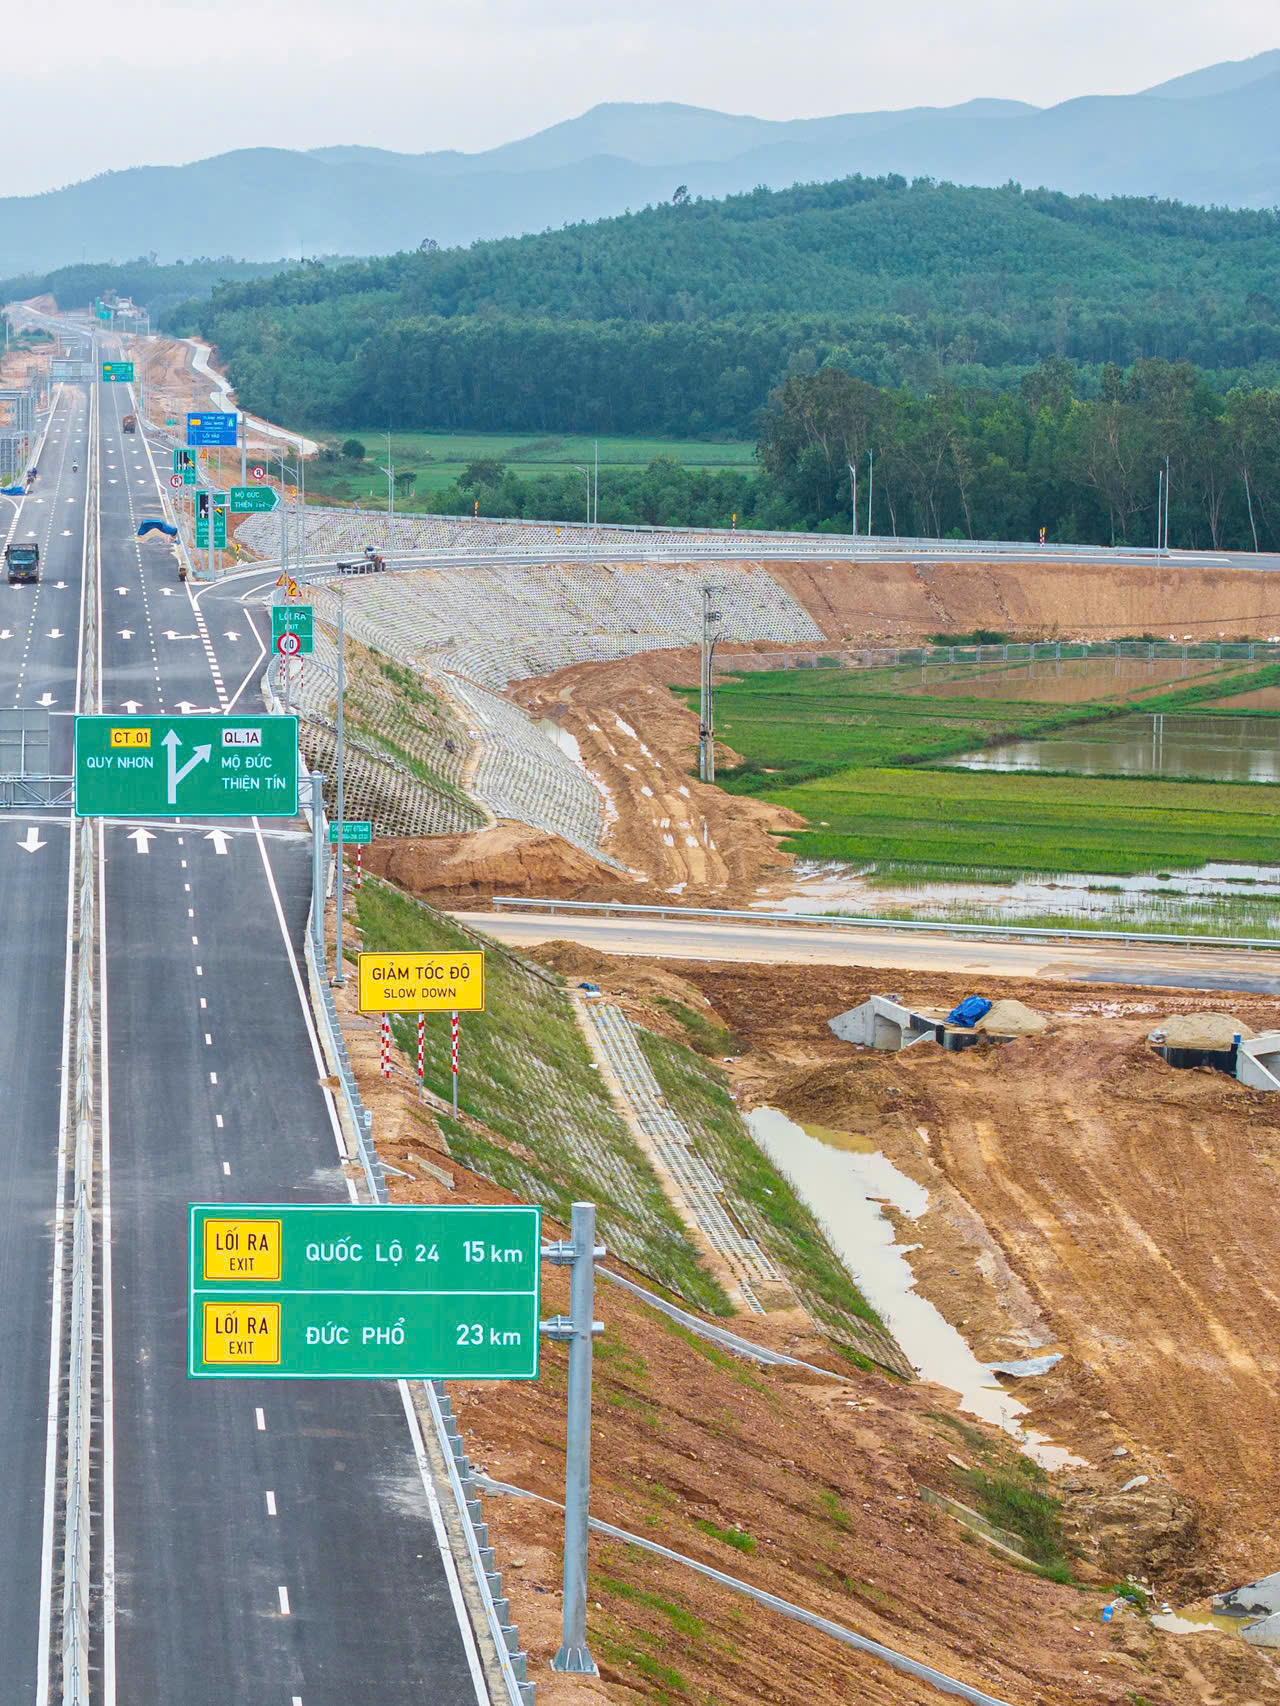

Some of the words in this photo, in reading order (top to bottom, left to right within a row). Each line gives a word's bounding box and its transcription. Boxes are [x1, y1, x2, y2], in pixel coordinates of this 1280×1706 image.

[294, 612, 306, 620] RA
[225, 732, 259, 743] QL.1A
[87, 757, 113, 768] QUY
[118, 756, 153, 768] NHƠN
[222, 754, 240, 770] MỘ
[245, 754, 272, 768] ĐỨC
[222, 775, 259, 791] THIỆN
[265, 774, 285, 789] TÍN
[372, 962, 409, 980] GIẢM
[415, 961, 444, 979] TỐC
[449, 963, 469, 982] ĐỘ
[384, 987, 417, 999] SLOW
[421, 987, 457, 999] DOWN
[216, 1227, 239, 1250] LỐI
[248, 1234, 268, 1251] RA
[306, 1236, 362, 1261] QUỐC
[376, 1239, 402, 1267] LỘ
[416, 1244, 439, 1261] 24
[230, 1257, 254, 1271] EXIT
[216, 1310, 238, 1334] LỐI
[248, 1317, 268, 1334] RA
[306, 1321, 349, 1344] ĐỨC
[363, 1317, 405, 1344] PHỔ
[229, 1341, 254, 1354] EXIT
